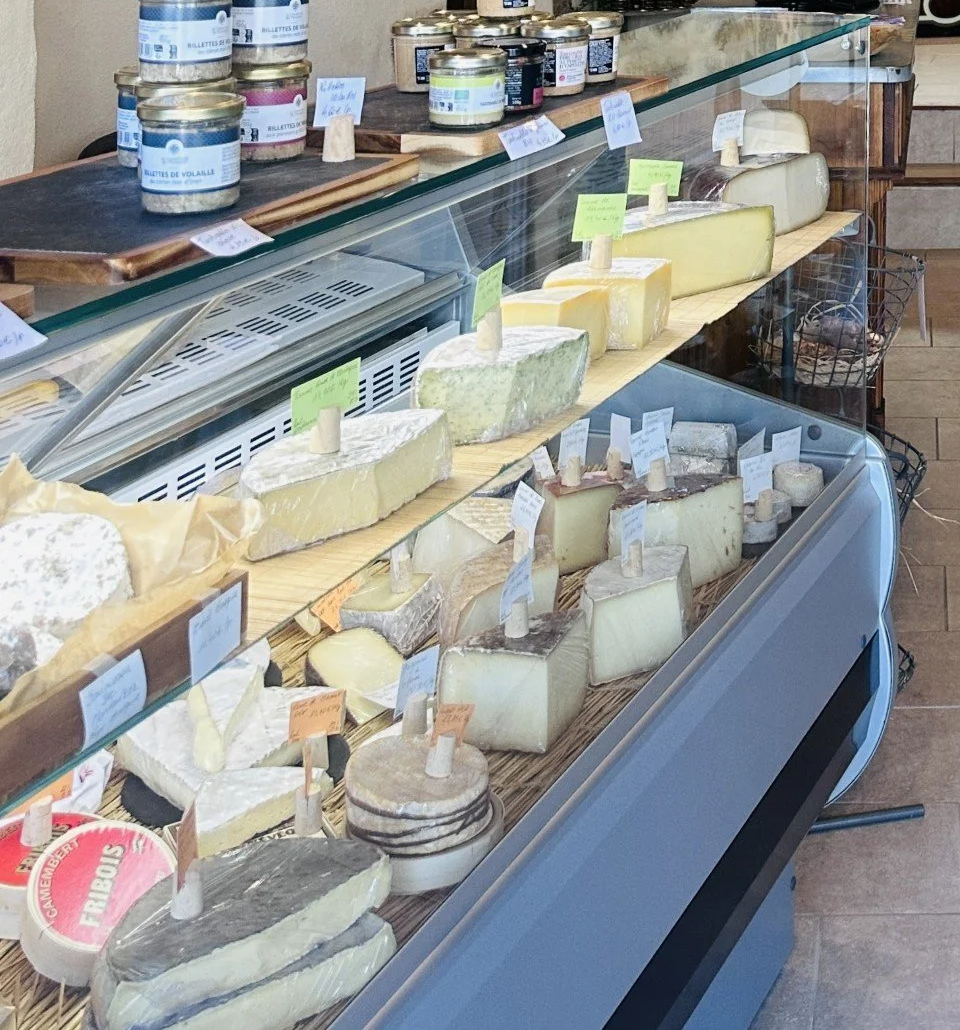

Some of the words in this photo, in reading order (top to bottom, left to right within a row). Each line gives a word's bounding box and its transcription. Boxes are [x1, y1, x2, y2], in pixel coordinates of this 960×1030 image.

[187, 41, 218, 49] RILLETTES
[170, 170, 179, 178] DE
[181, 168, 215, 178] VOLAILLE
[40, 838, 80, 919] CAMEMBERT
[79, 843, 126, 927] FRIBOIS
